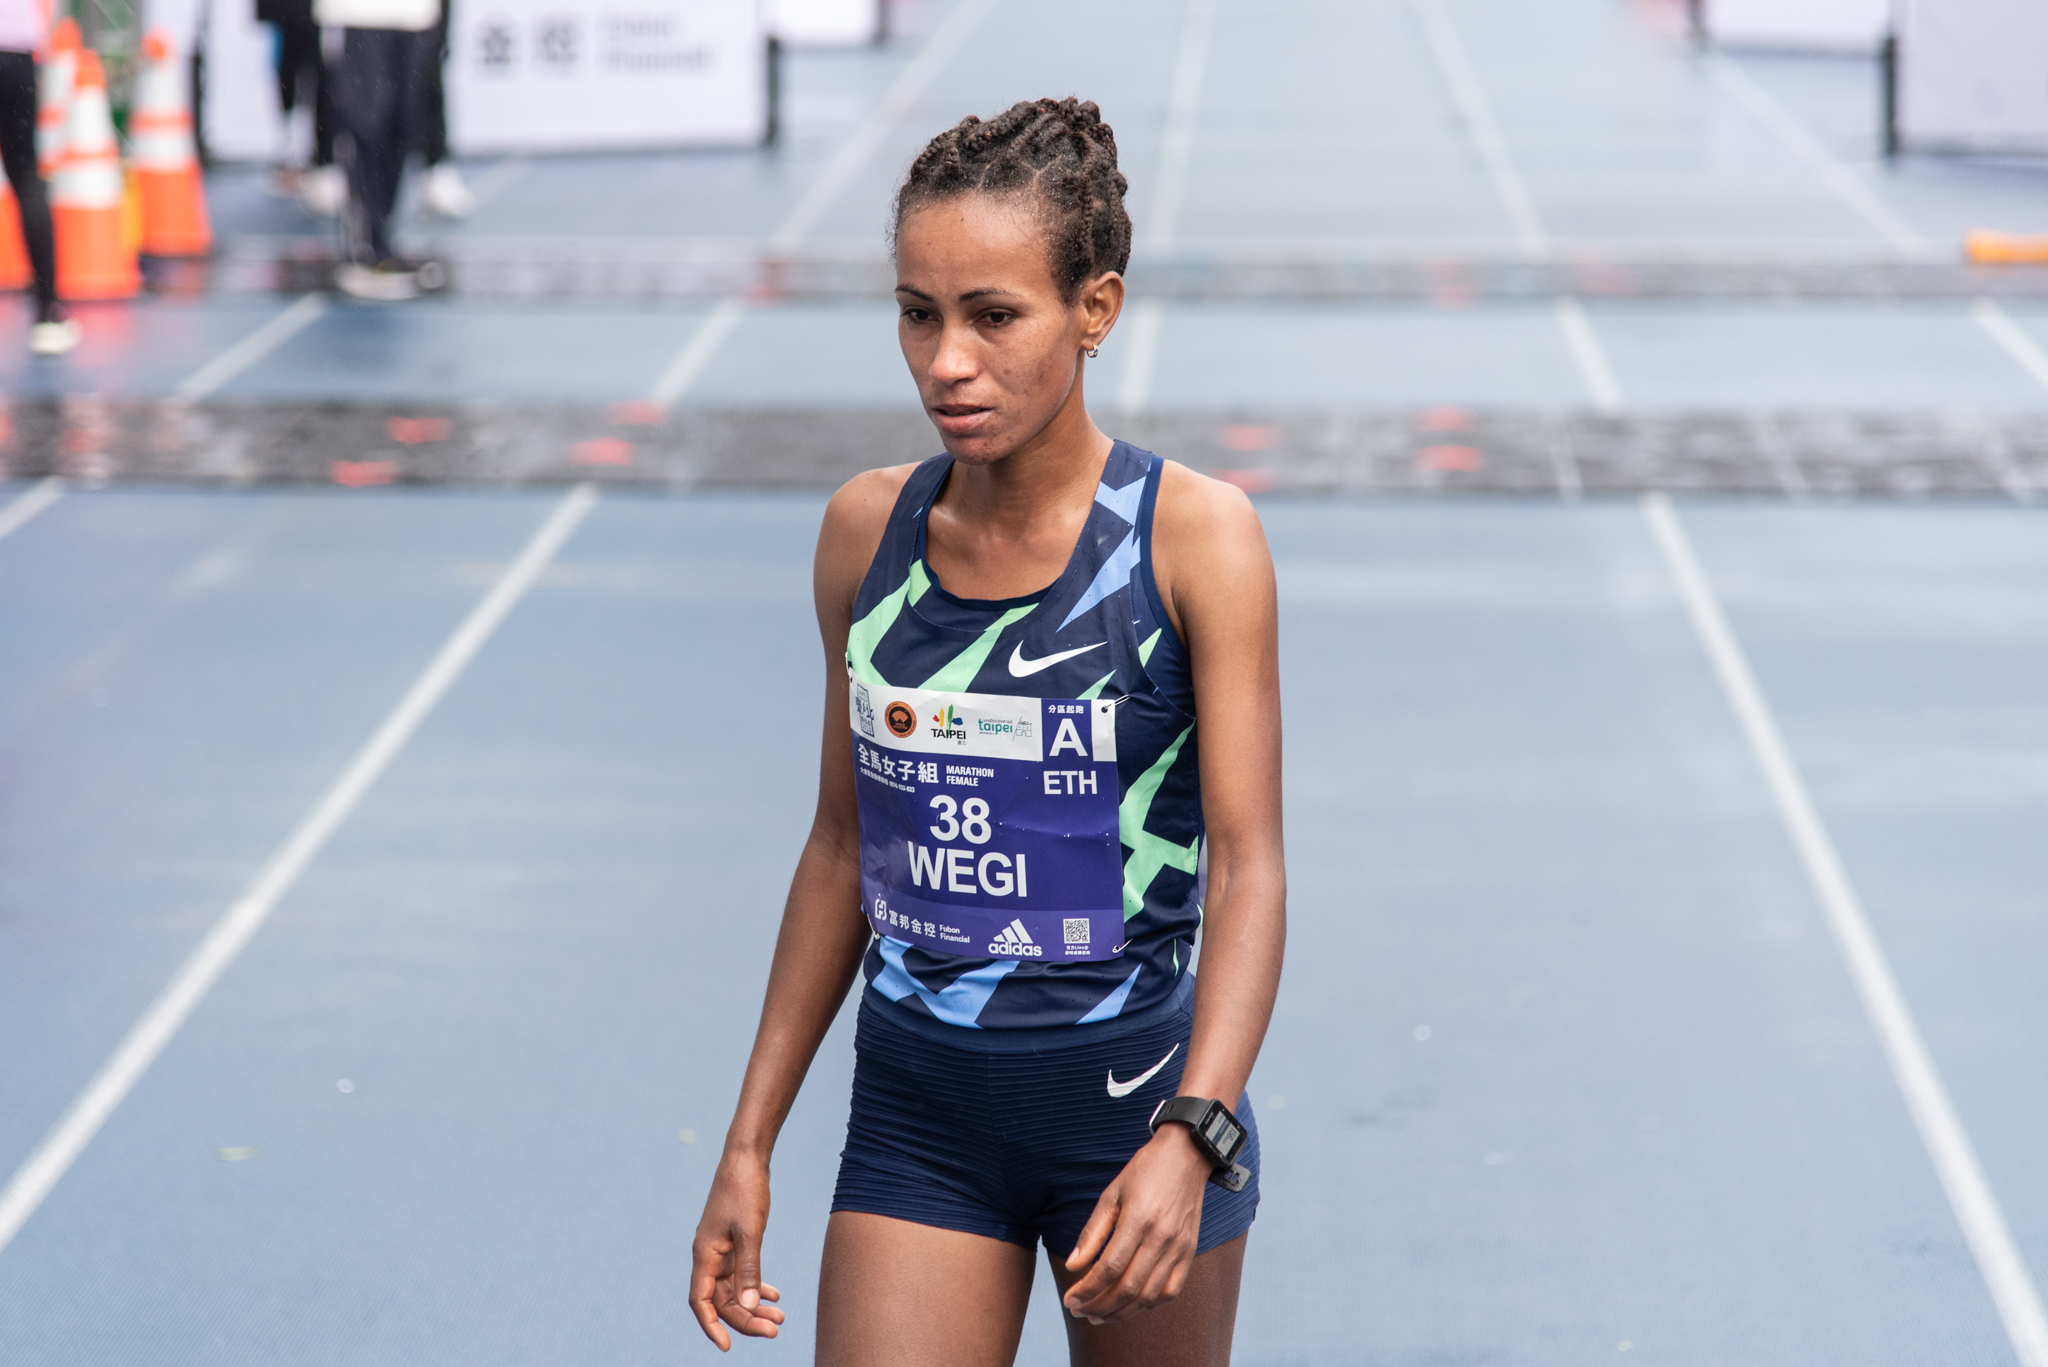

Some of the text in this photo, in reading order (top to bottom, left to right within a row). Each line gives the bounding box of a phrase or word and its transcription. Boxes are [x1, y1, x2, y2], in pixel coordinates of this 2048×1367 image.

[1048, 705, 1085, 714] 分區起跑
[930, 728, 966, 740] TAIPEI
[978, 718, 1013, 735] taipei
[1049, 718, 1088, 756] A
[858, 743, 939, 784] 全馬女子組
[946, 765, 994, 778] MARATHON
[946, 775, 979, 787] FEMALE
[1043, 770, 1098, 795] ETH
[929, 794, 992, 845] 38
[907, 840, 1028, 898] WEGI
[888, 909, 937, 938] 富邦金控
[939, 925, 960, 934] Fubon
[939, 932, 970, 943] Financial
[987, 941, 1043, 957] adidas
